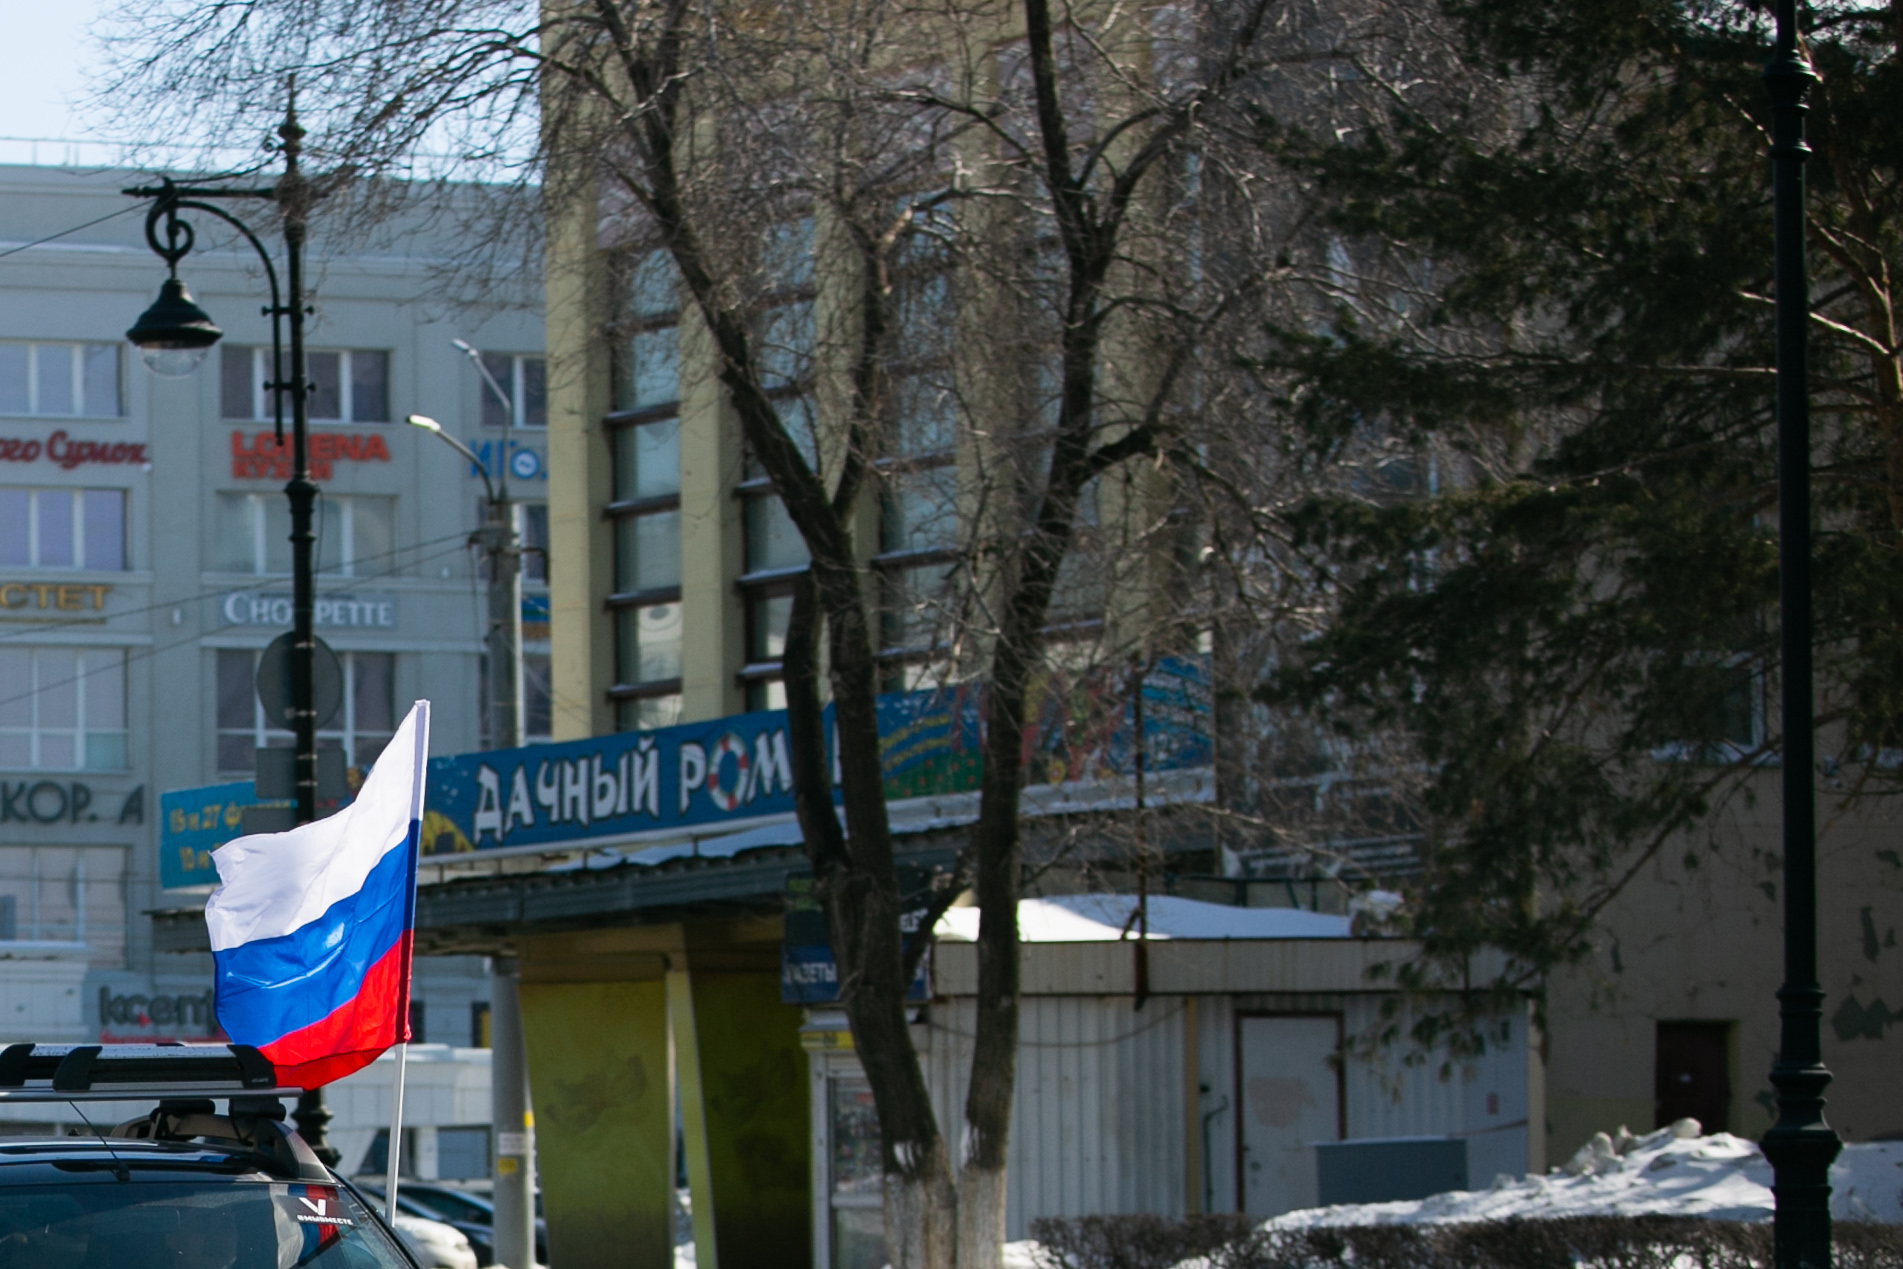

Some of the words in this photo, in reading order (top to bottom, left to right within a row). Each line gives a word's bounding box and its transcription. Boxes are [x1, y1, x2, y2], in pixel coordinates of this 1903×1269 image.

[232, 459, 333, 481] КУХИ
[473, 734, 660, 846] ДАЧНЫЙ
[99, 986, 217, 1032] kcent
[298, 1197, 326, 1216] V
